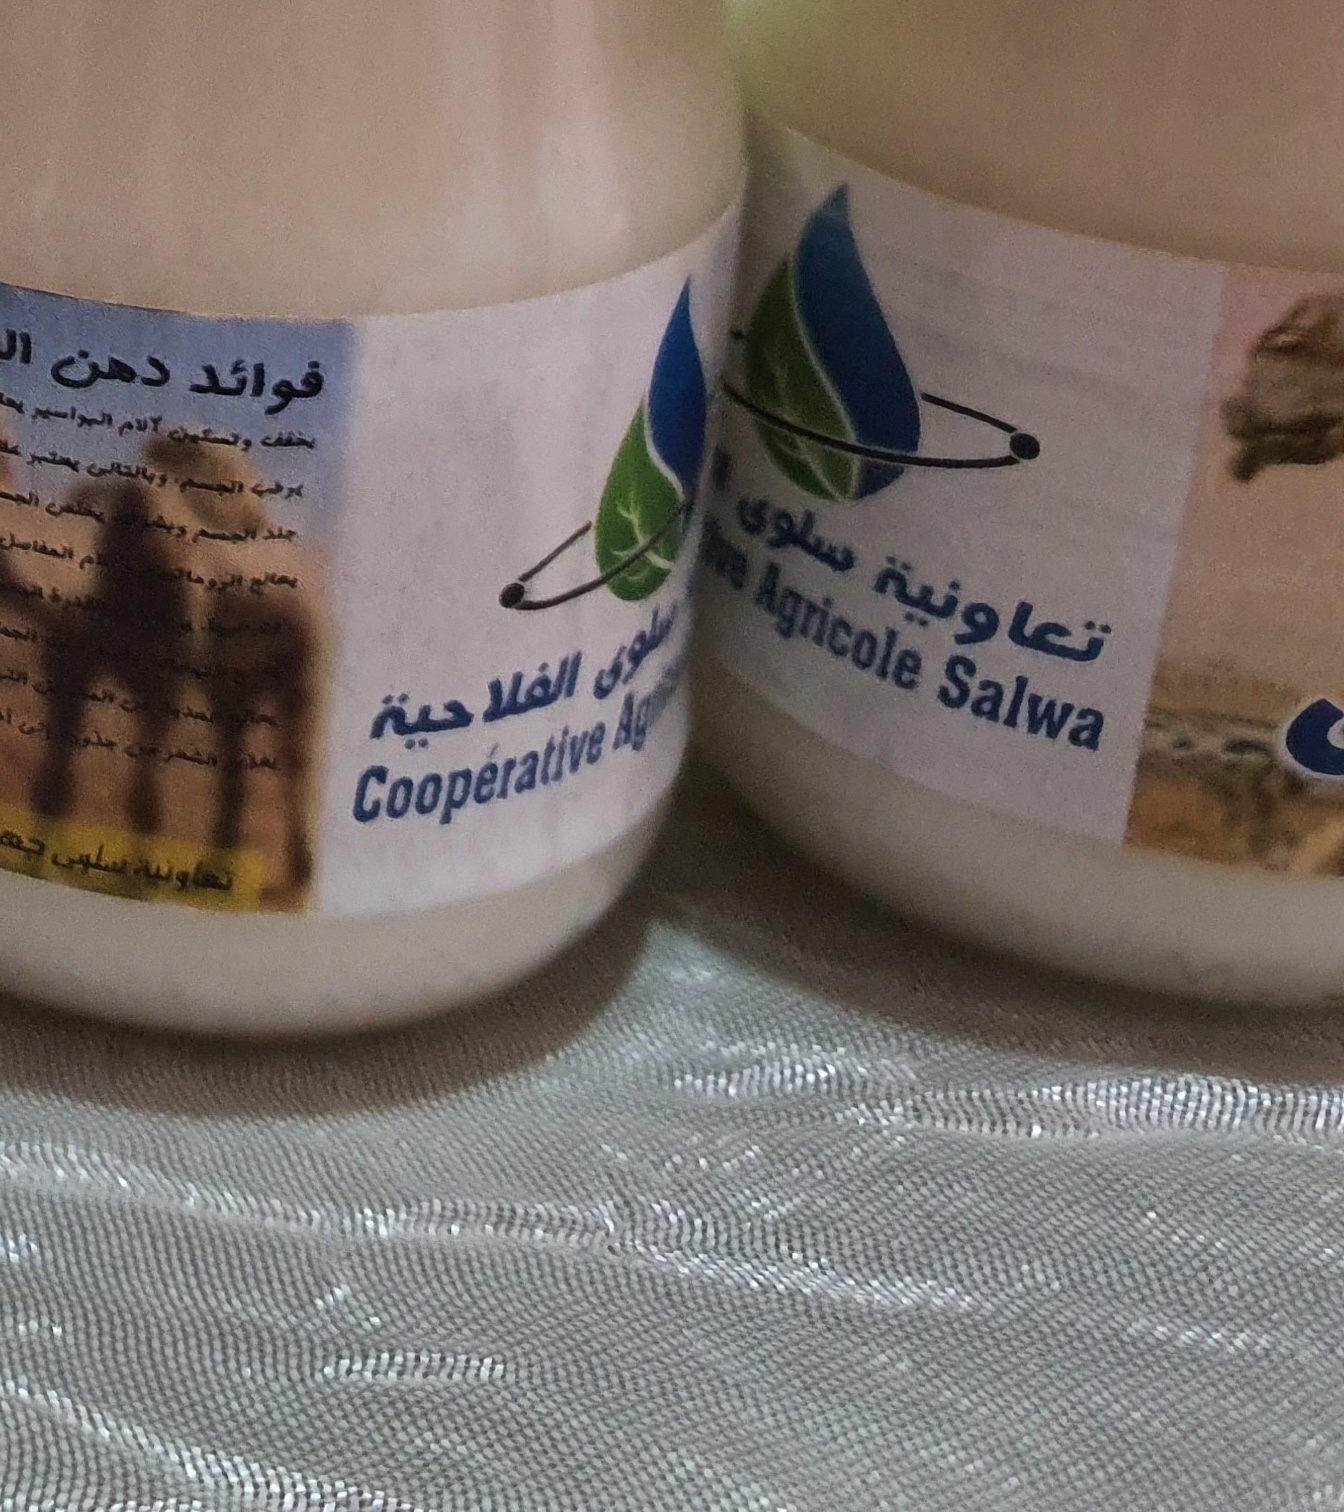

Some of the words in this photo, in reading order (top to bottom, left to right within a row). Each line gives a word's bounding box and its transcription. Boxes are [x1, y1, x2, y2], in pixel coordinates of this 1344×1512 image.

[50, 349, 170, 389] دهن
[189, 360, 325, 416] فوائد
[754, 561, 923, 691] Agricole
[937, 653, 1104, 751] Salwa
[871, 554, 1111, 663] تعاونية
[369, 650, 584, 749] الفلاحية
[352, 721, 606, 825] Coopérative
